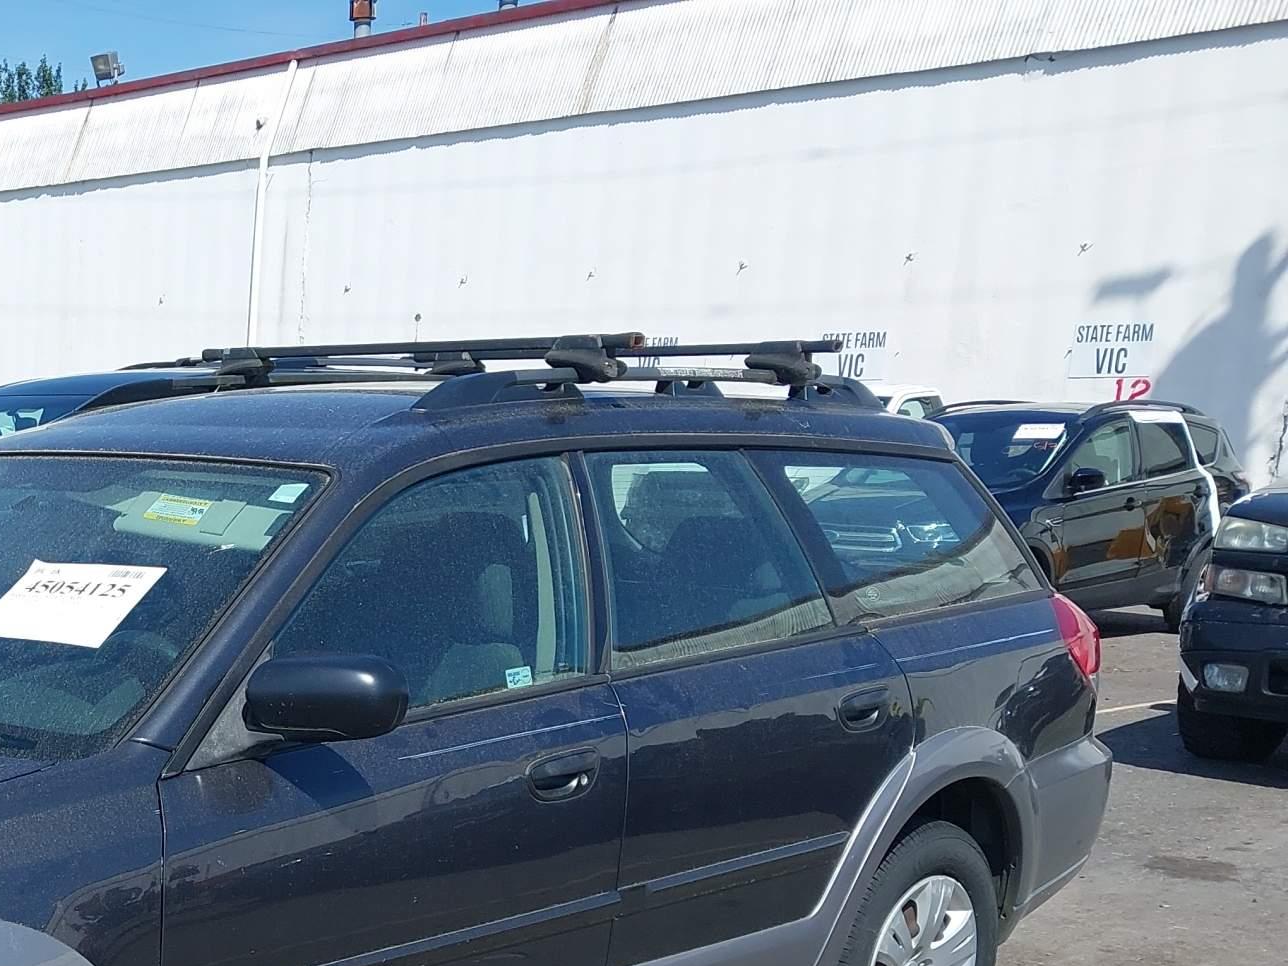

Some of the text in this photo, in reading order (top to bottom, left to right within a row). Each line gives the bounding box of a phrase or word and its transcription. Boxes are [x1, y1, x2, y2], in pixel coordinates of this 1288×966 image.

[855, 331, 887, 349] FARM
[1076, 323, 1154, 343] STATE FARM
[838, 353, 865, 378] VIC
[1096, 347, 1128, 374] VIC
[1115, 379, 1151, 401] 12
[24, 580, 132, 598] 45054125
